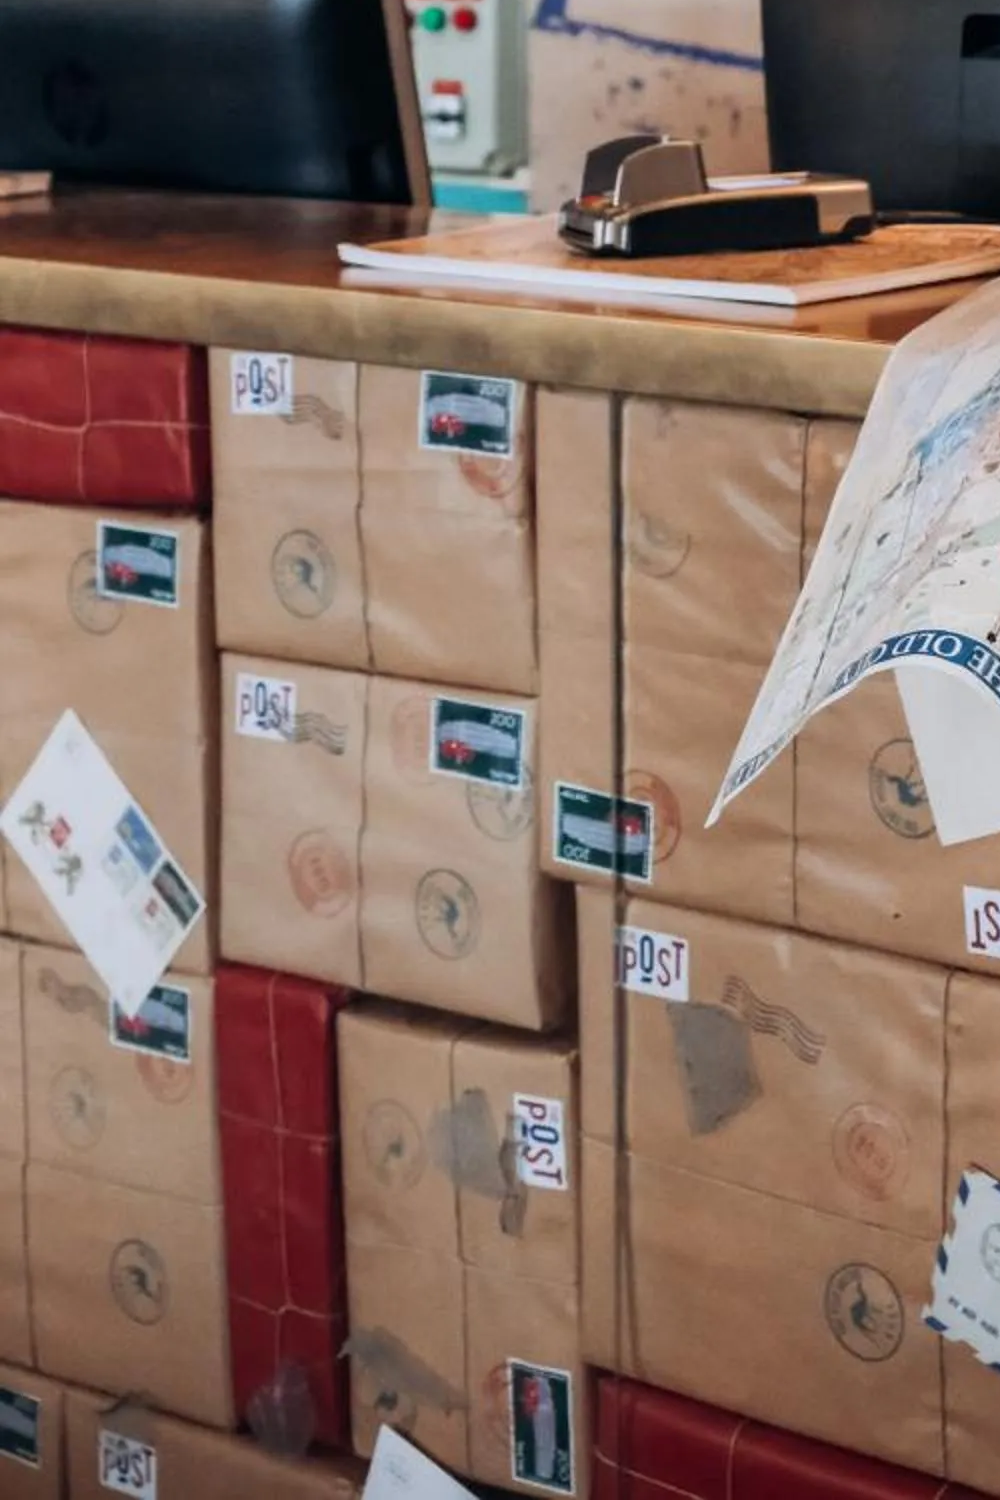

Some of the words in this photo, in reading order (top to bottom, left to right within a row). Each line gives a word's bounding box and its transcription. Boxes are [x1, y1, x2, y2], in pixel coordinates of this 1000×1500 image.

[235, 357, 289, 408] POST
[892, 632, 964, 658] OLD
[240, 681, 293, 728] POST
[615, 934, 685, 987] POST
[518, 1100, 563, 1186] POST
